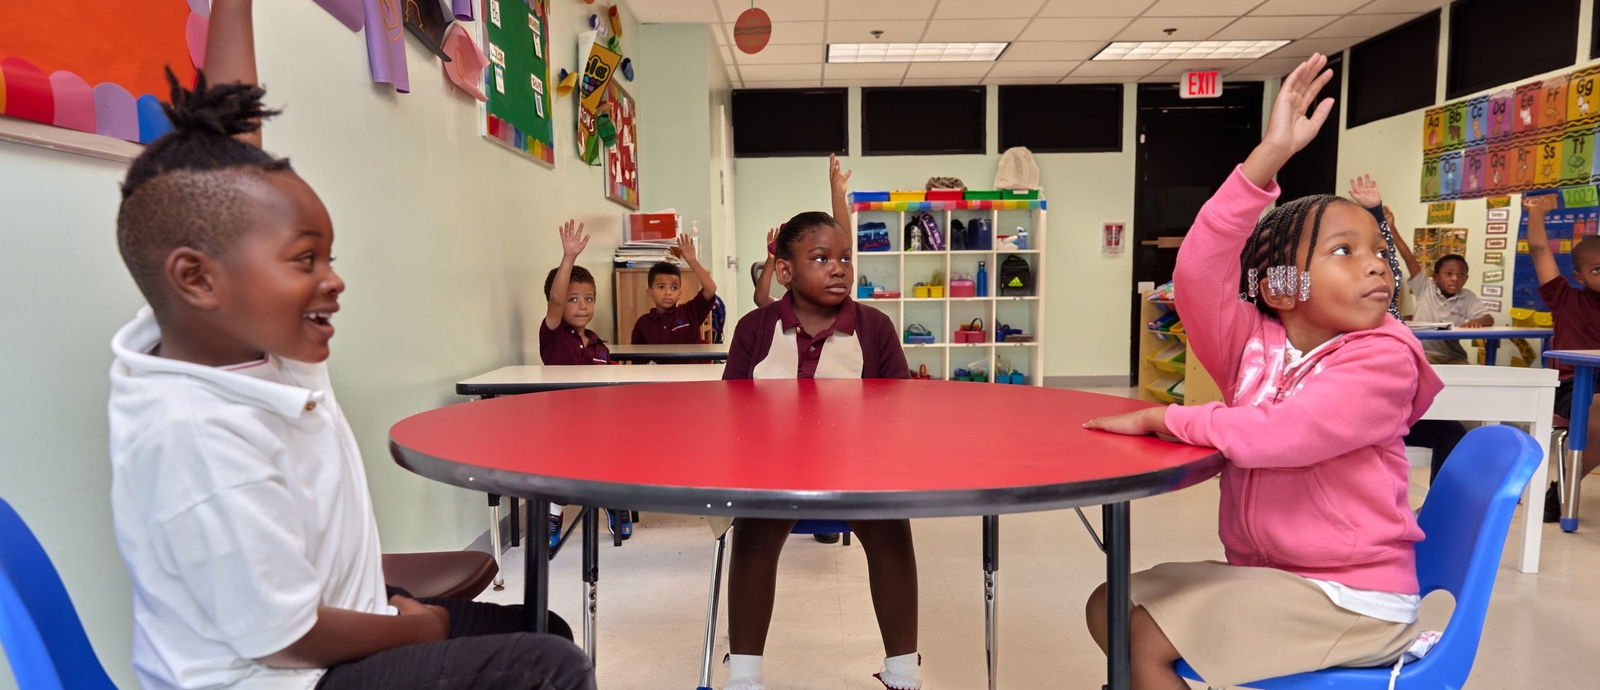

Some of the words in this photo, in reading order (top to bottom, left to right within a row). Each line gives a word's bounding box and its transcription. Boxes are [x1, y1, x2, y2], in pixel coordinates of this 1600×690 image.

[1188, 71, 1219, 95] EXIT
[1576, 78, 1594, 96] Gg
[1521, 93, 1534, 109] Ee
[1546, 87, 1560, 103] Ff
[1471, 106, 1483, 119] Cc
[1492, 101, 1506, 115] Dd
[1427, 116, 1439, 129] Aa
[1448, 110, 1461, 124] Bb
[1543, 144, 1556, 159] Ss
[1572, 138, 1585, 154] Tt
[1490, 153, 1505, 169] Qq
[1517, 147, 1530, 163] Rr
[1425, 163, 1437, 177] Nn
[1443, 160, 1456, 174] Oo
[1469, 156, 1482, 173] Pp
[1566, 189, 1597, 205] 2022
